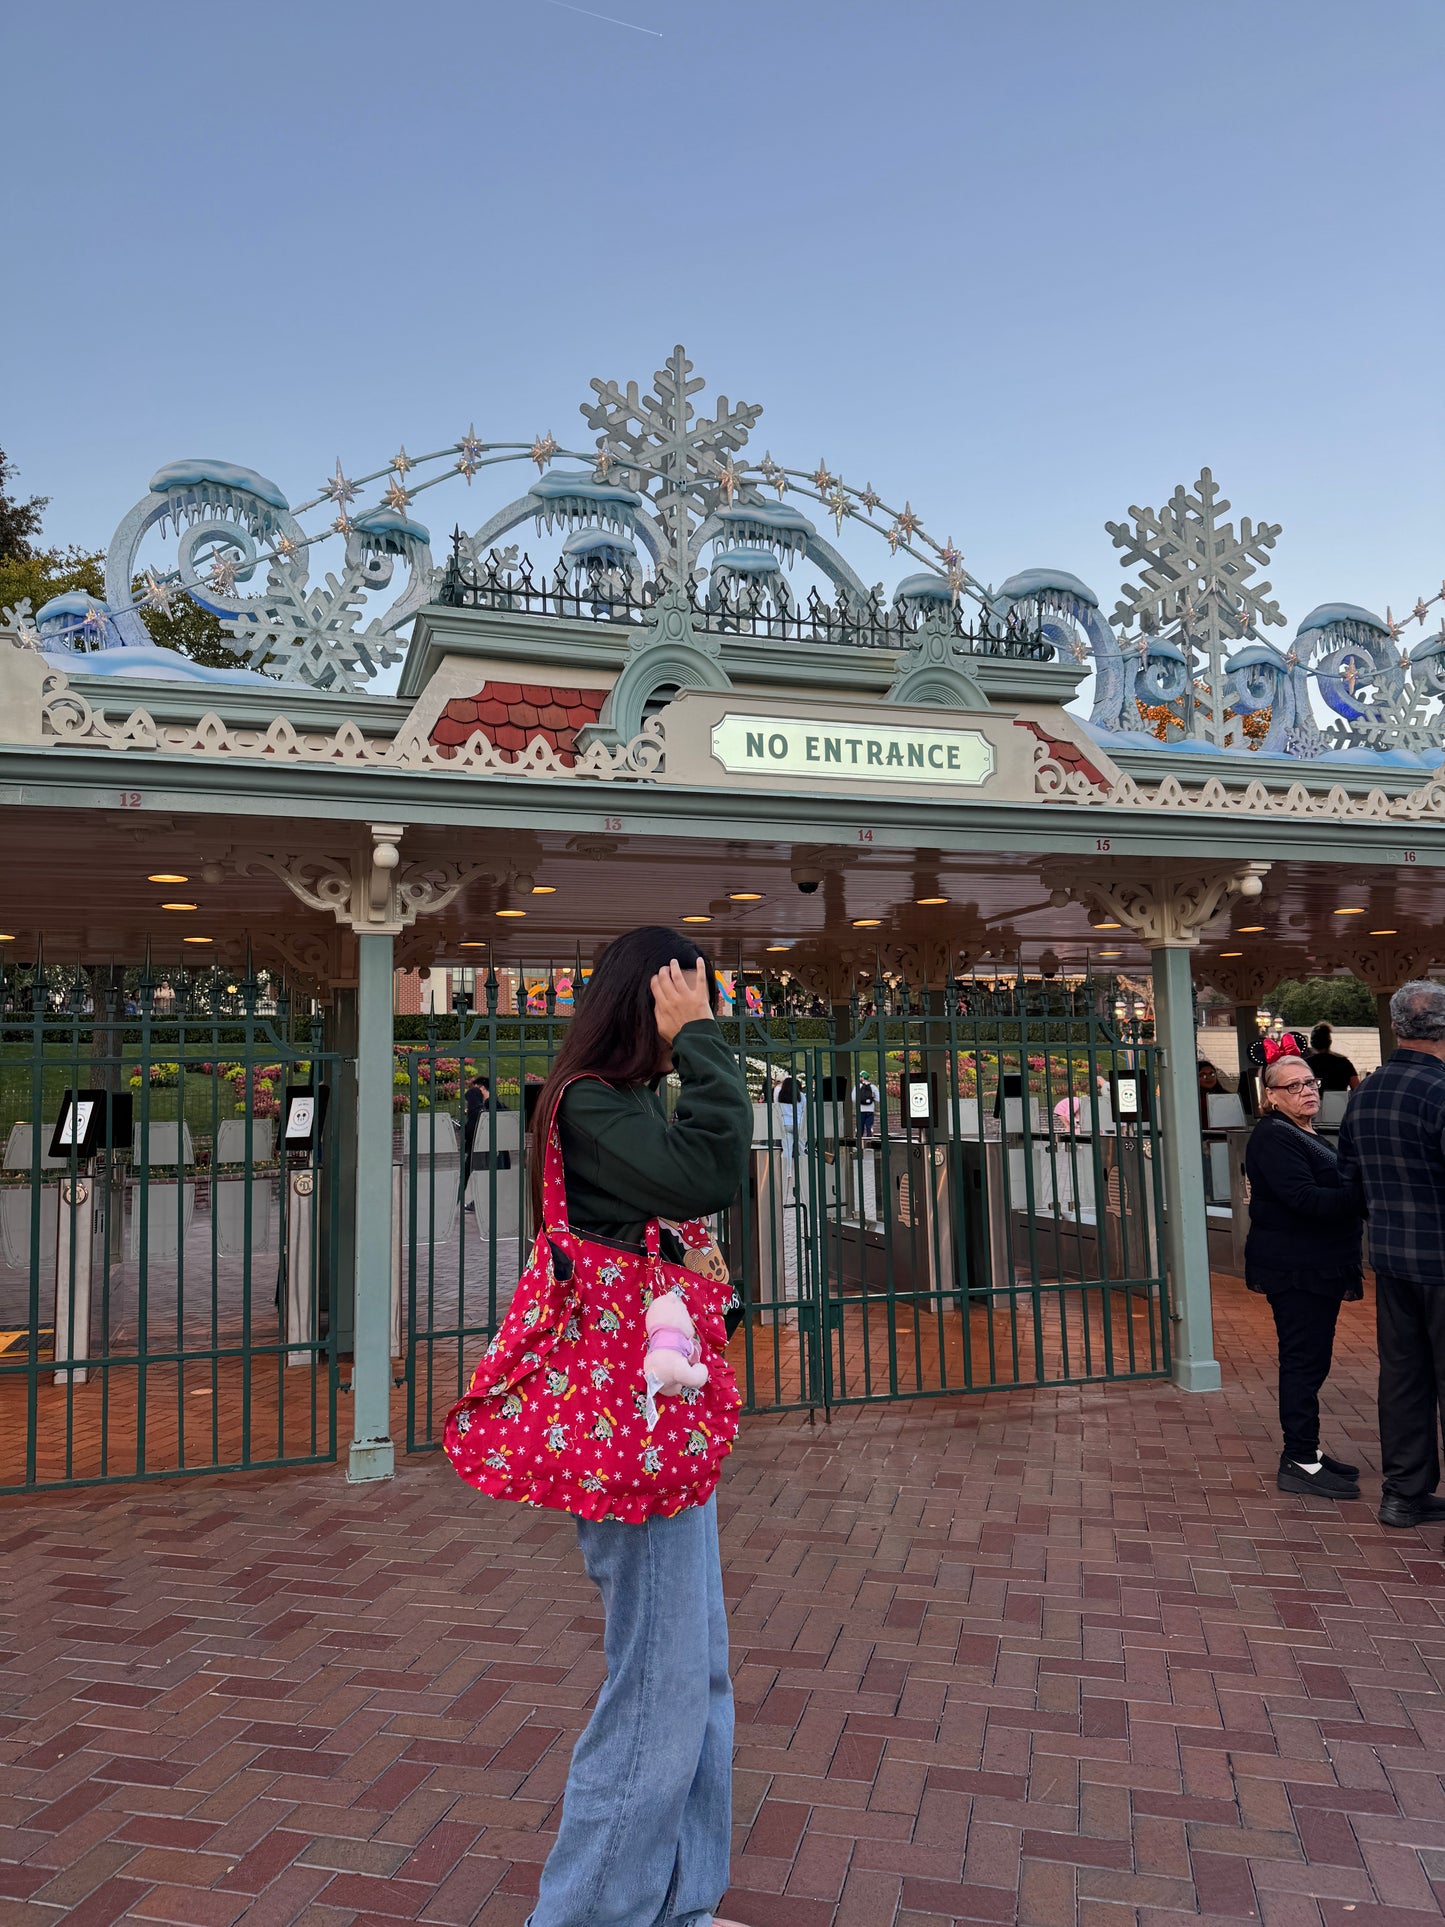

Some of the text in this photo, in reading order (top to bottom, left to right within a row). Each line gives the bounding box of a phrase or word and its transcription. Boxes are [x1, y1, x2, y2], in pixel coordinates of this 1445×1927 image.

[746, 732, 961, 770] NO ENTRANCE
[120, 792, 142, 807] 12
[604, 817, 622, 831] 13
[858, 829, 873, 842] 14
[1096, 839, 1111, 851] 15
[1403, 851, 1416, 862] 16
